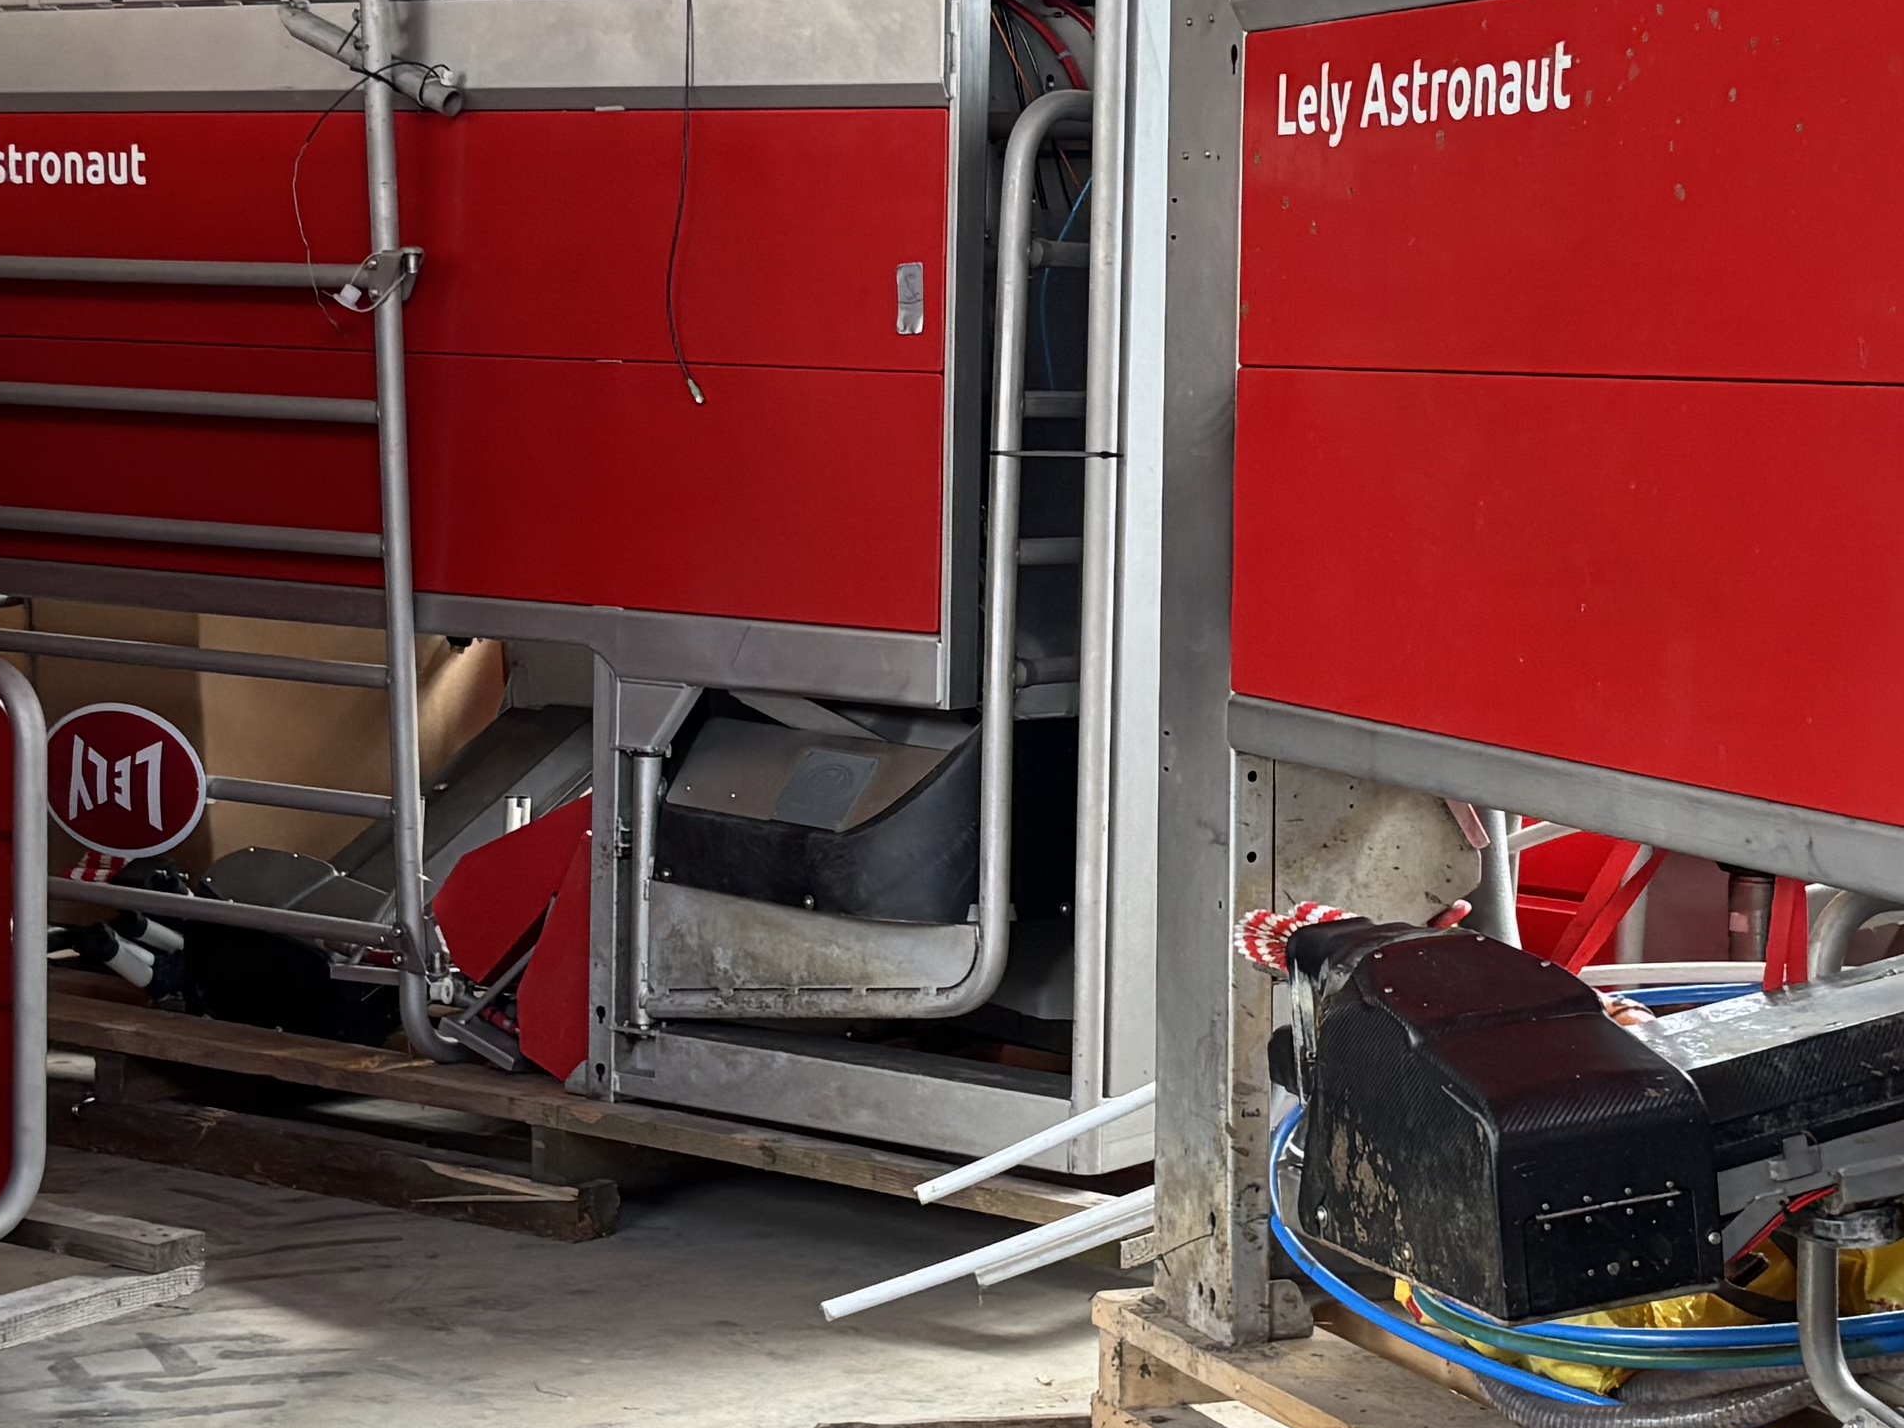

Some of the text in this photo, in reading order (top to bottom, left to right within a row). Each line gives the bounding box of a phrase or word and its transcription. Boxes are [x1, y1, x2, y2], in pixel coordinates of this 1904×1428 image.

[1277, 40, 1573, 148] Lely Astronaut
[68, 733, 164, 833] LELY
